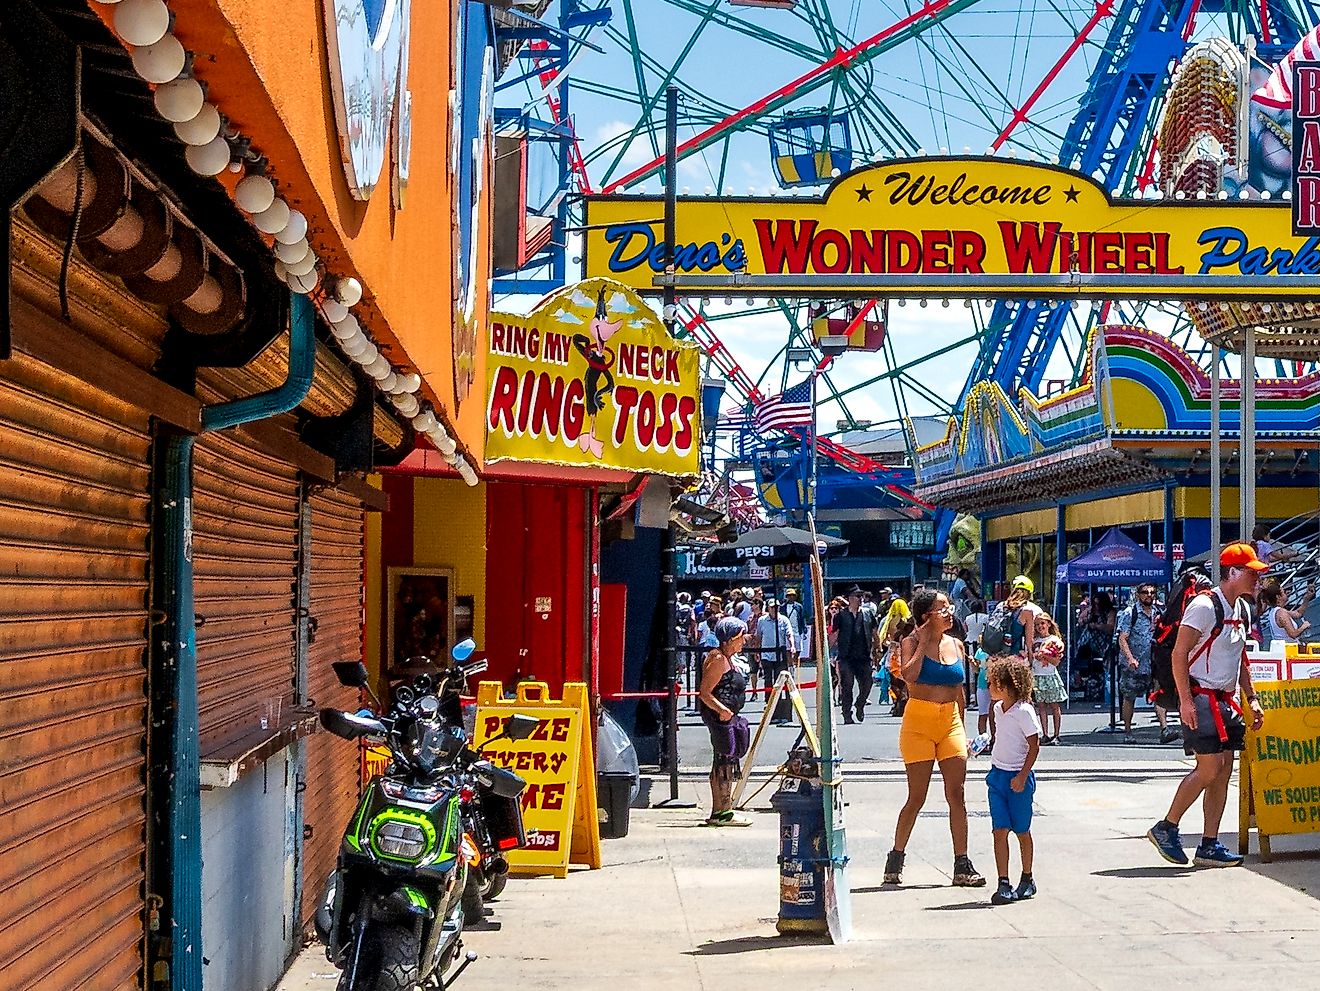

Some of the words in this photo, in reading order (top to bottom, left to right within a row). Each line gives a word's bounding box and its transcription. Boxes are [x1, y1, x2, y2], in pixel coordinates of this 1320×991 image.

[884, 172, 1051, 207] Welcome
[604, 221, 746, 273] Deno's
[752, 218, 986, 274] WONDER
[996, 220, 1184, 275] WHEEL
[490, 322, 540, 362] RING
[541, 332, 573, 366] MY
[616, 342, 681, 386] NECK
[488, 365, 586, 448] RING
[611, 385, 697, 457] TOSS
[736, 546, 775, 558] PEPSI
[1087, 569, 1105, 578] BUY
[1106, 569, 1141, 578] TICKETS
[1142, 569, 1165, 578] HERE
[1256, 688, 1282, 710] RESH
[484, 716, 571, 741] PZE
[481, 750, 568, 775] EVERY
[521, 782, 566, 814] ME
[1263, 788, 1283, 806] WE
[1289, 806, 1308, 823] TO
